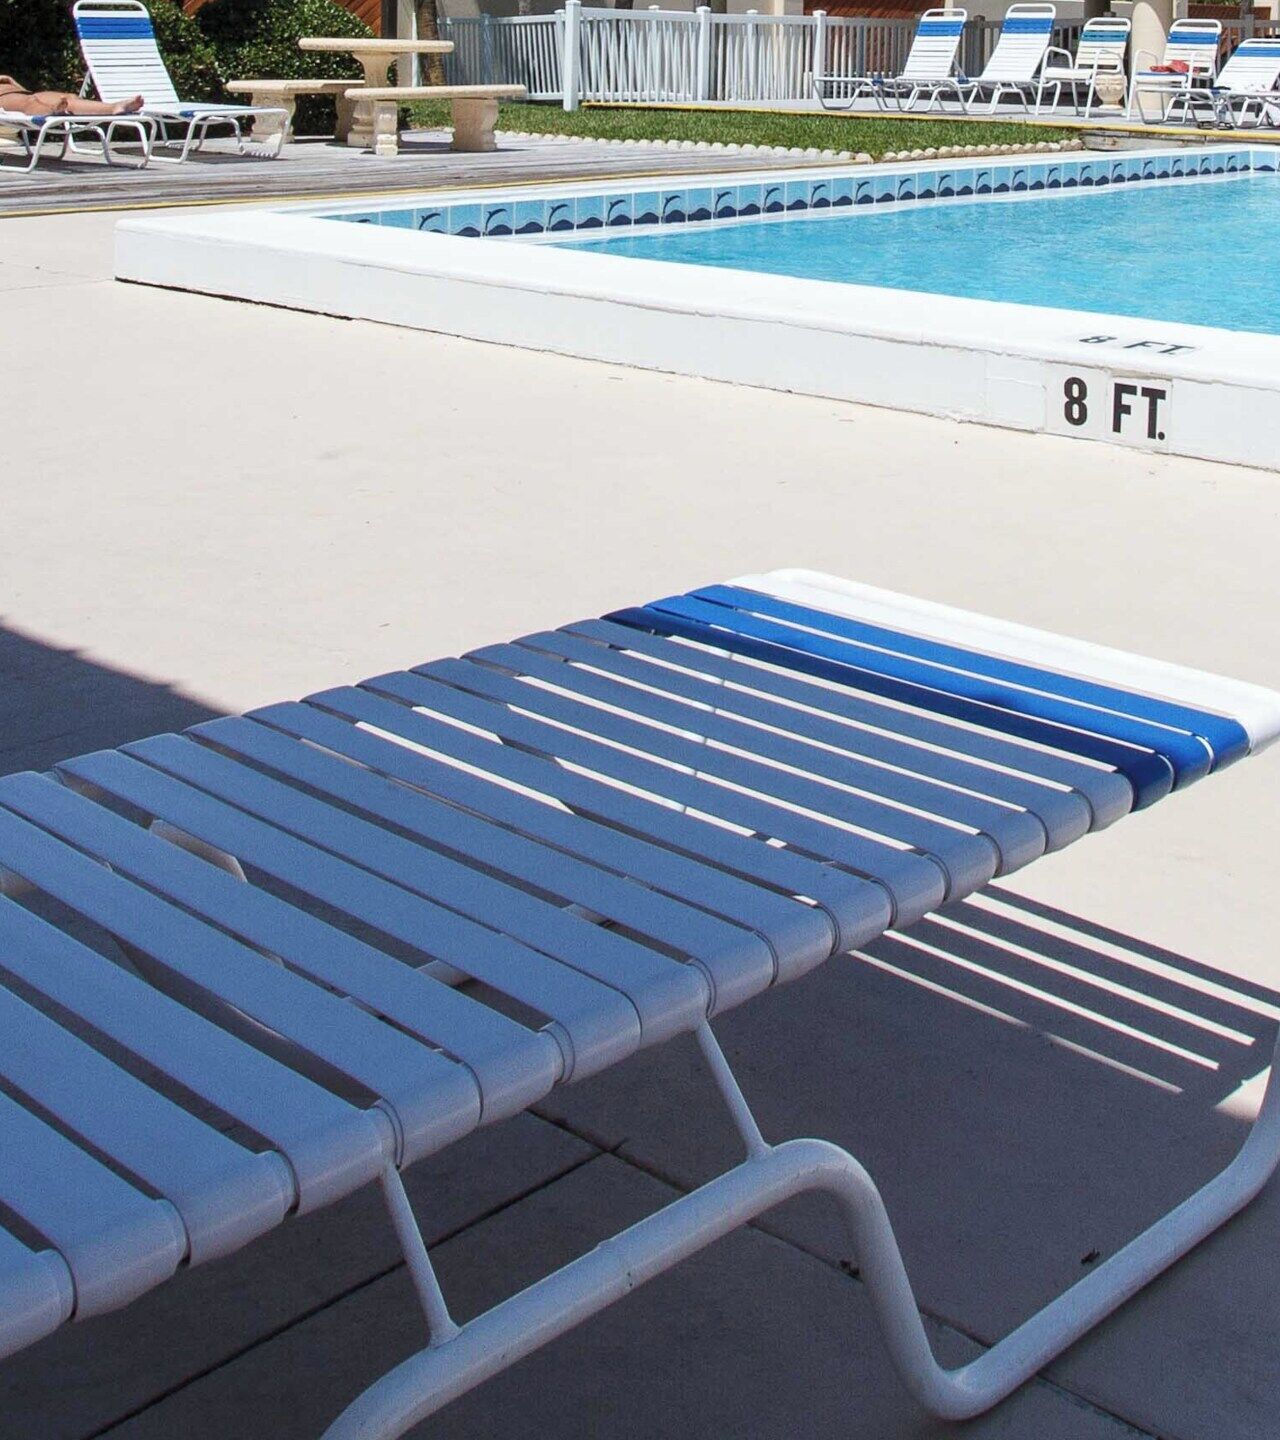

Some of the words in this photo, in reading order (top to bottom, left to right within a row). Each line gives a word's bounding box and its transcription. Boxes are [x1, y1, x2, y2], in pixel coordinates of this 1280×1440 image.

[1078, 335, 1118, 344] 8
[1063, 376, 1088, 426] 8
[1112, 382, 1166, 441] FT.
